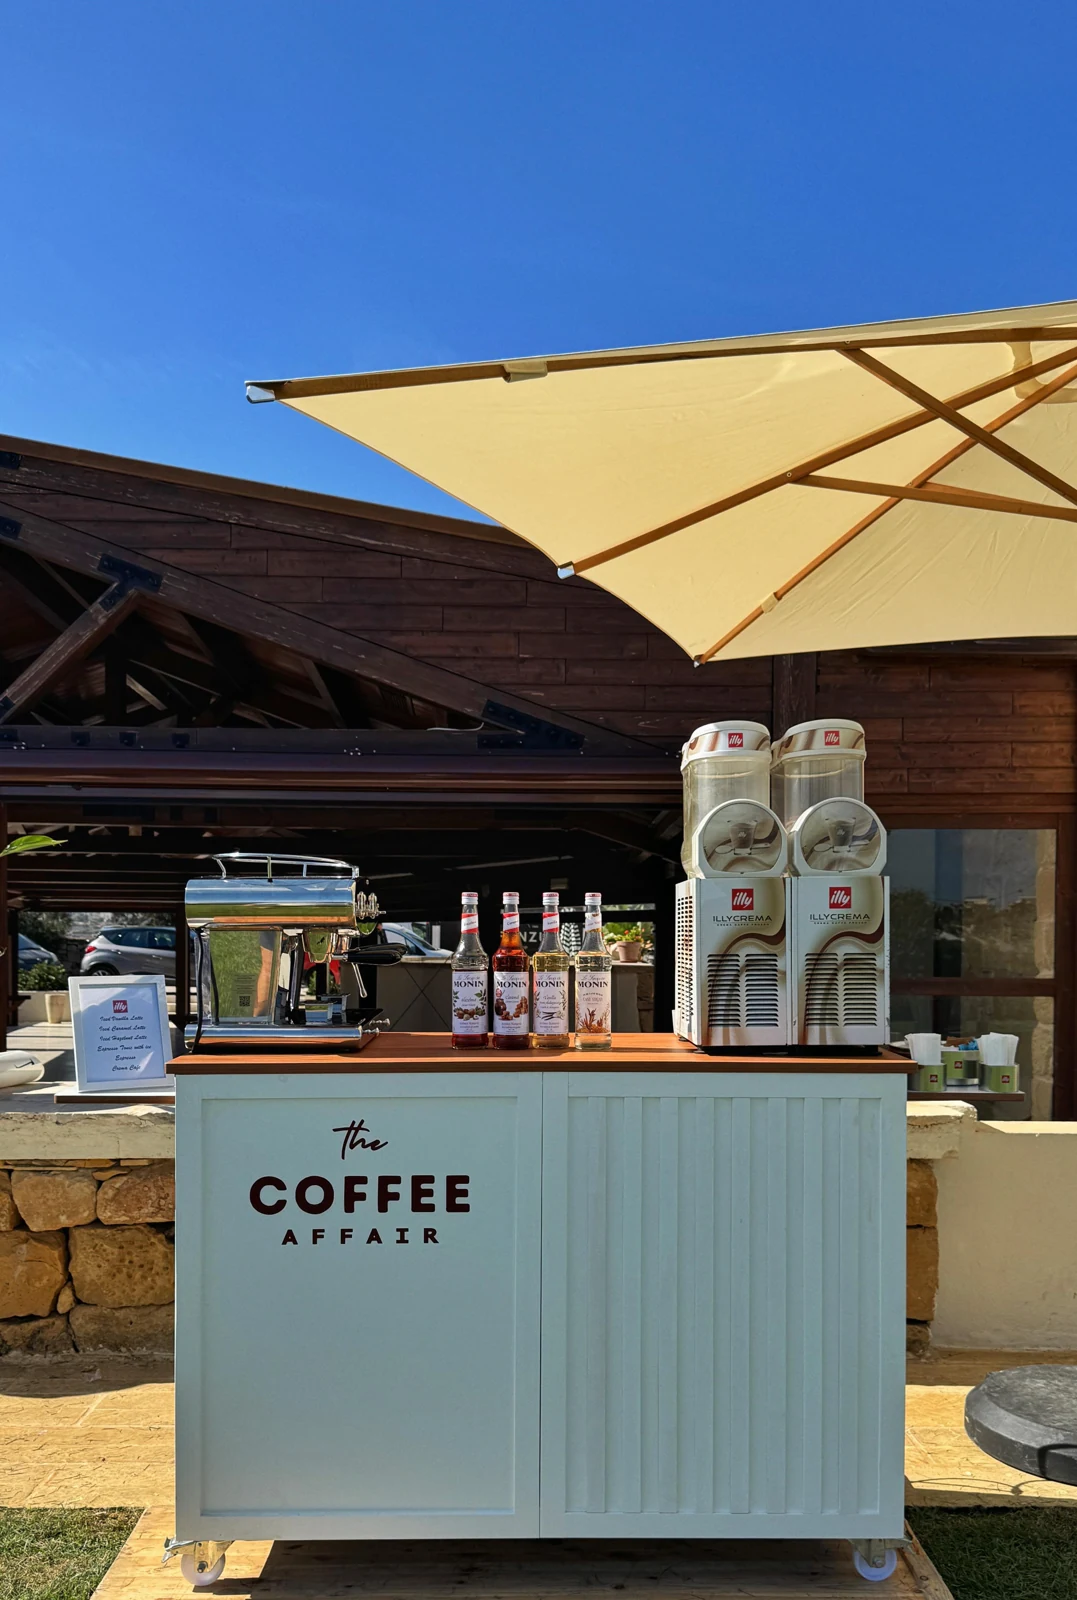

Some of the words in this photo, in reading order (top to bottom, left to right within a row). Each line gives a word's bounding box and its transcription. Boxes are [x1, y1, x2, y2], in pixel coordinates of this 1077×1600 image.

[728, 734, 742, 747] illy
[825, 732, 839, 745] illy
[733, 892, 752, 908] illy
[830, 890, 850, 907] illy
[453, 980, 485, 988] MONIN
[535, 980, 565, 988] MONIN
[578, 980, 608, 988] MONIN
[114, 1002, 127, 1011] illy
[249, 1174, 470, 1215] COFFEE
[281, 1228, 439, 1245] AFFAIR
